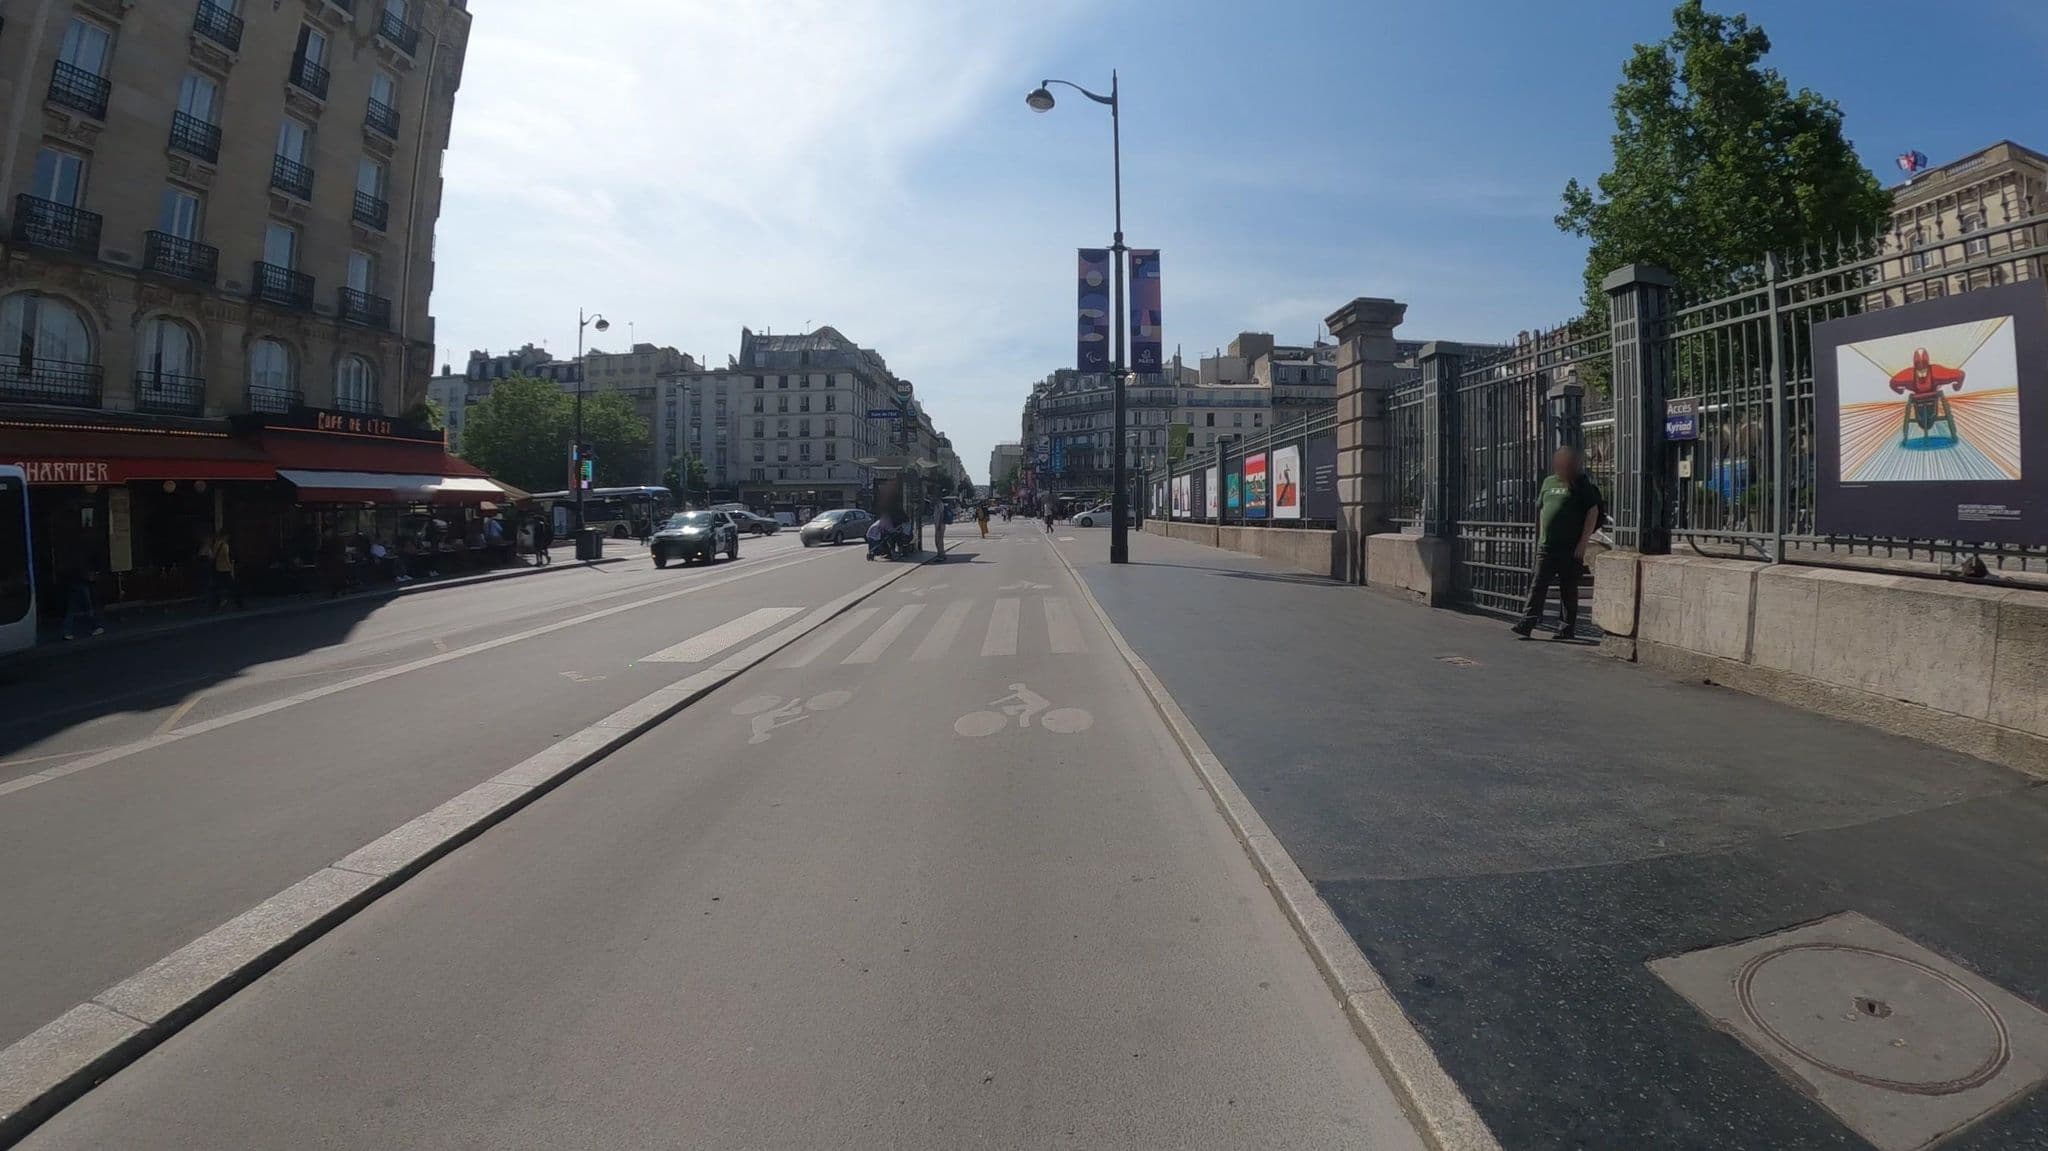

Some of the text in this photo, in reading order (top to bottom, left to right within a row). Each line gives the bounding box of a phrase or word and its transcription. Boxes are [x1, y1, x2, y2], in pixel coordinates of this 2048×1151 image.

[1667, 401, 1691, 415] Accès
[1666, 420, 1693, 434] Kyriad
[15, 461, 109, 482] HARTIER
